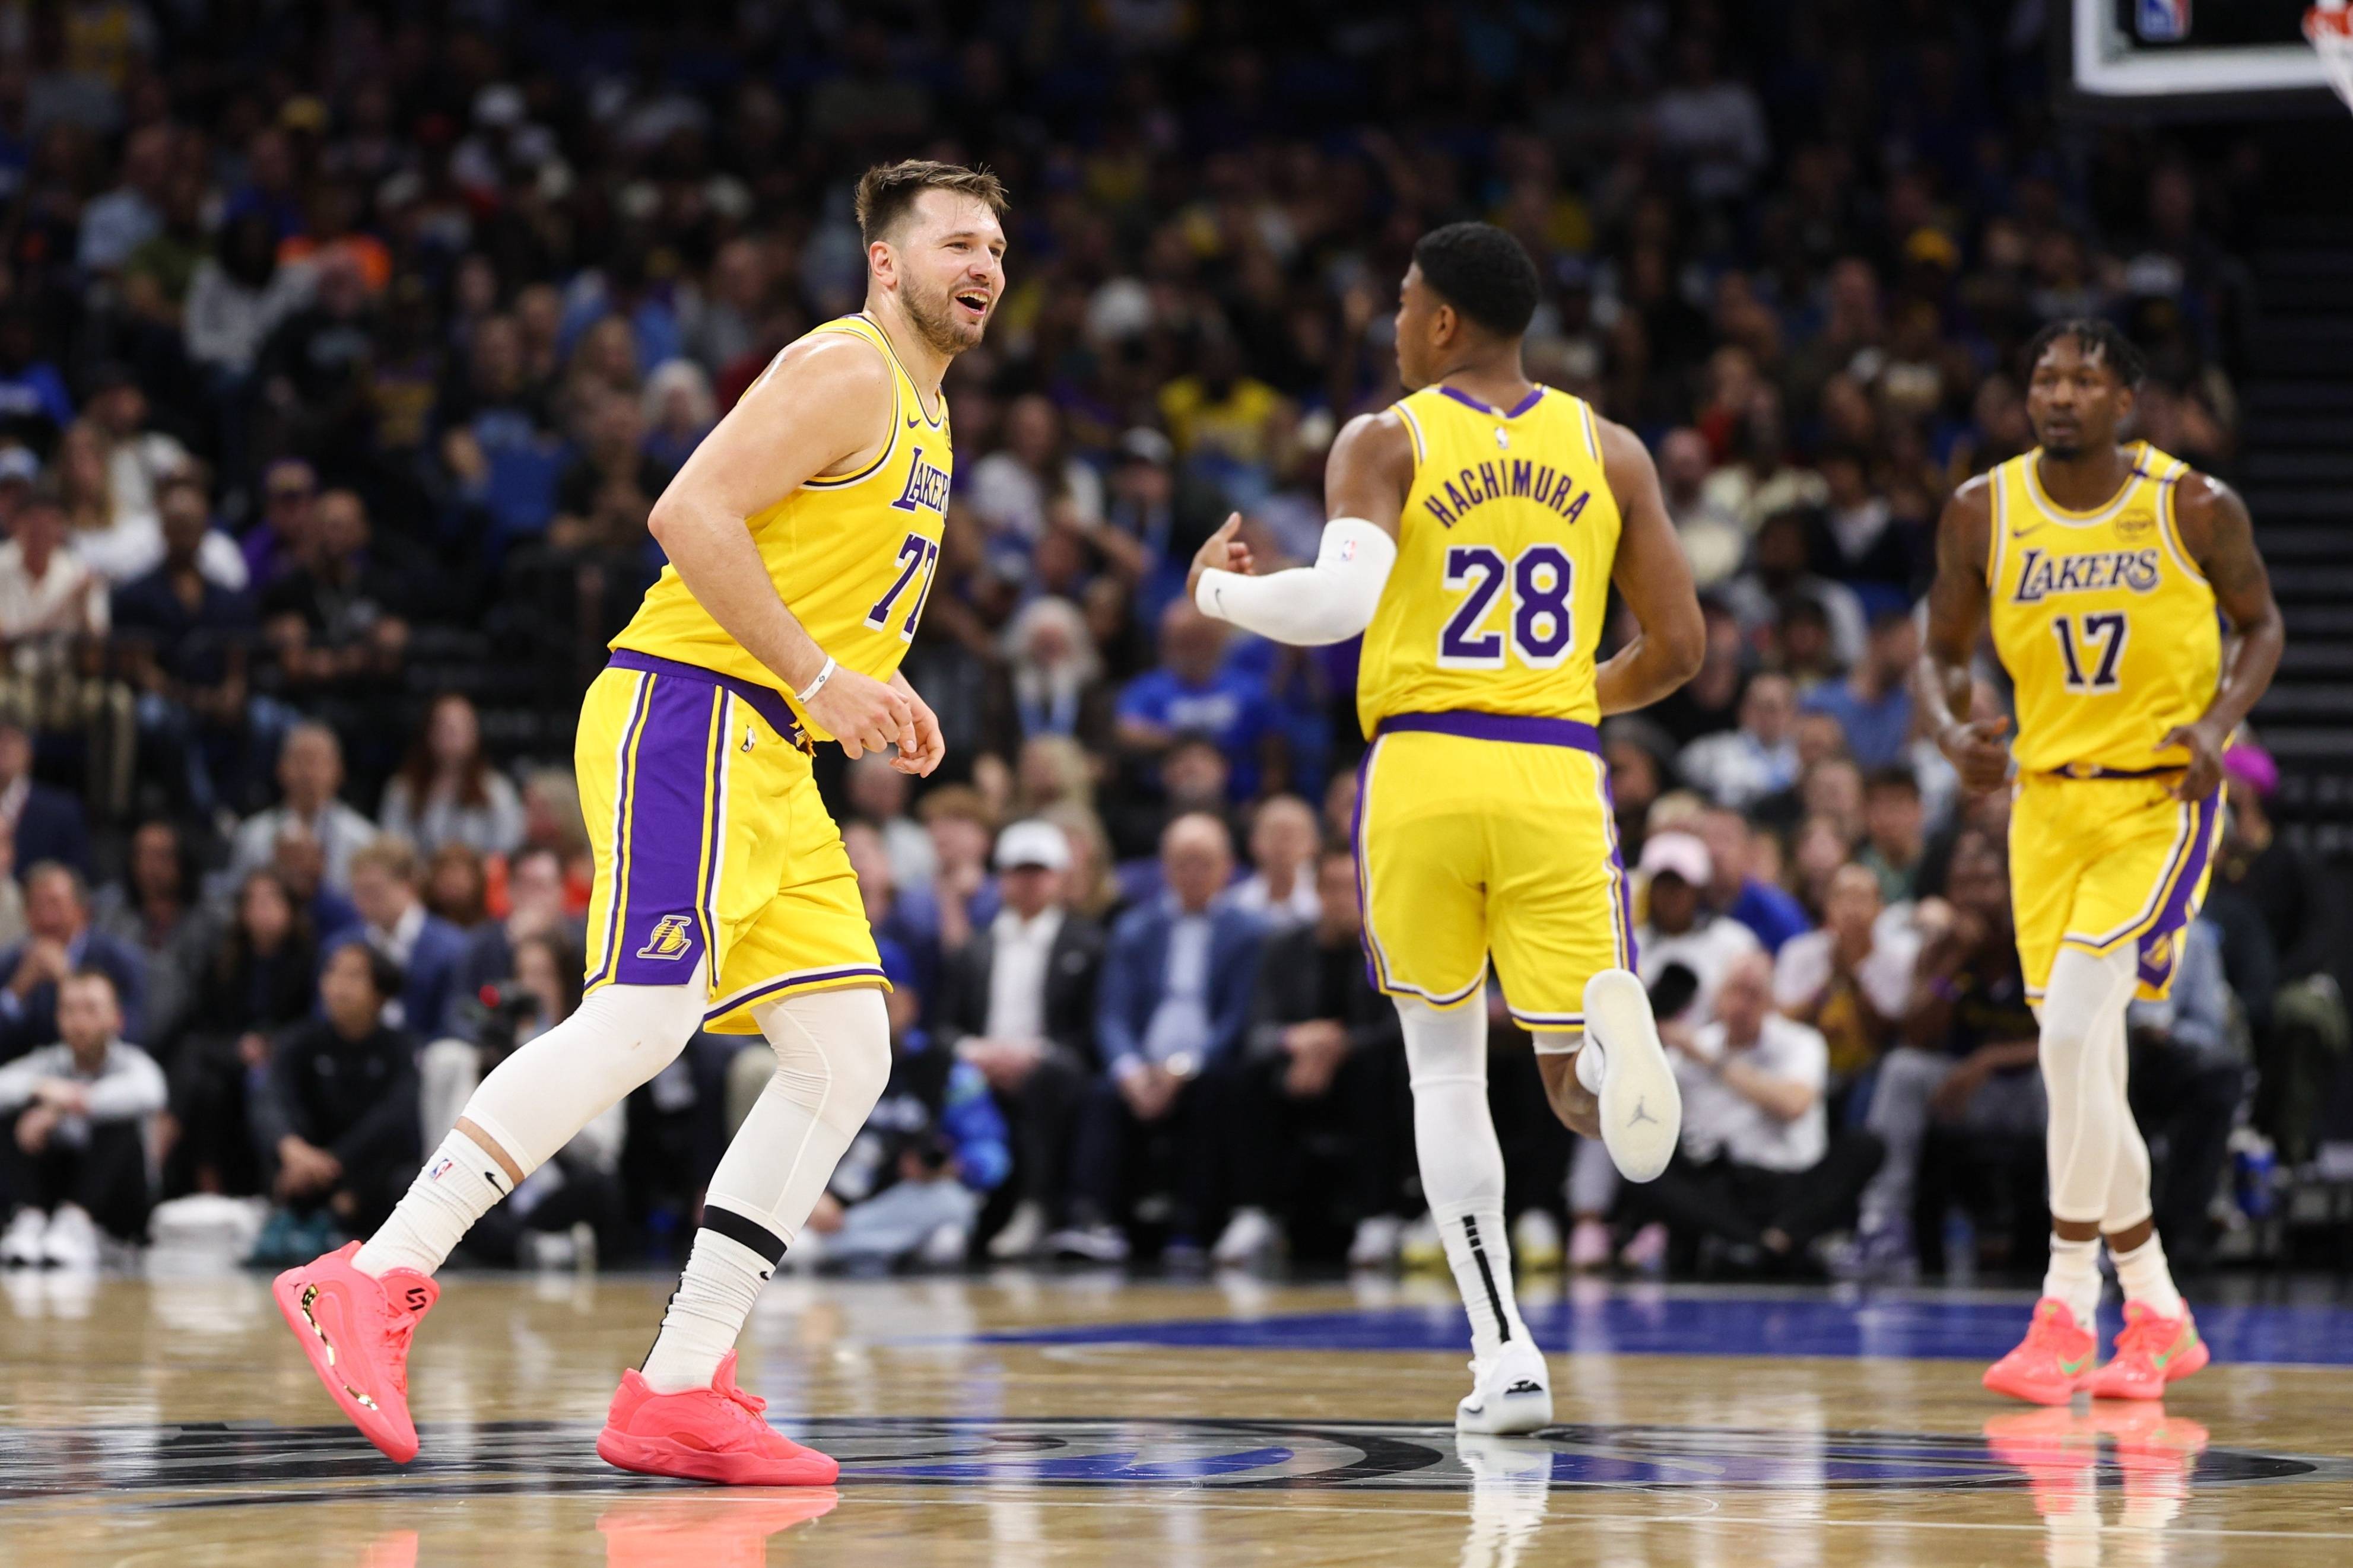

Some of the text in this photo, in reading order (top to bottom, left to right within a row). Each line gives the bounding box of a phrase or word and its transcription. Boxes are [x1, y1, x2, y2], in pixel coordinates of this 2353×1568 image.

[890, 446, 951, 519] LAKER
[1424, 459, 1590, 529] HACHIMURA
[866, 533, 938, 640] 77
[1439, 545, 1573, 667] 28
[2013, 549, 2160, 603] LAKERS
[2052, 612, 2127, 688] 17
